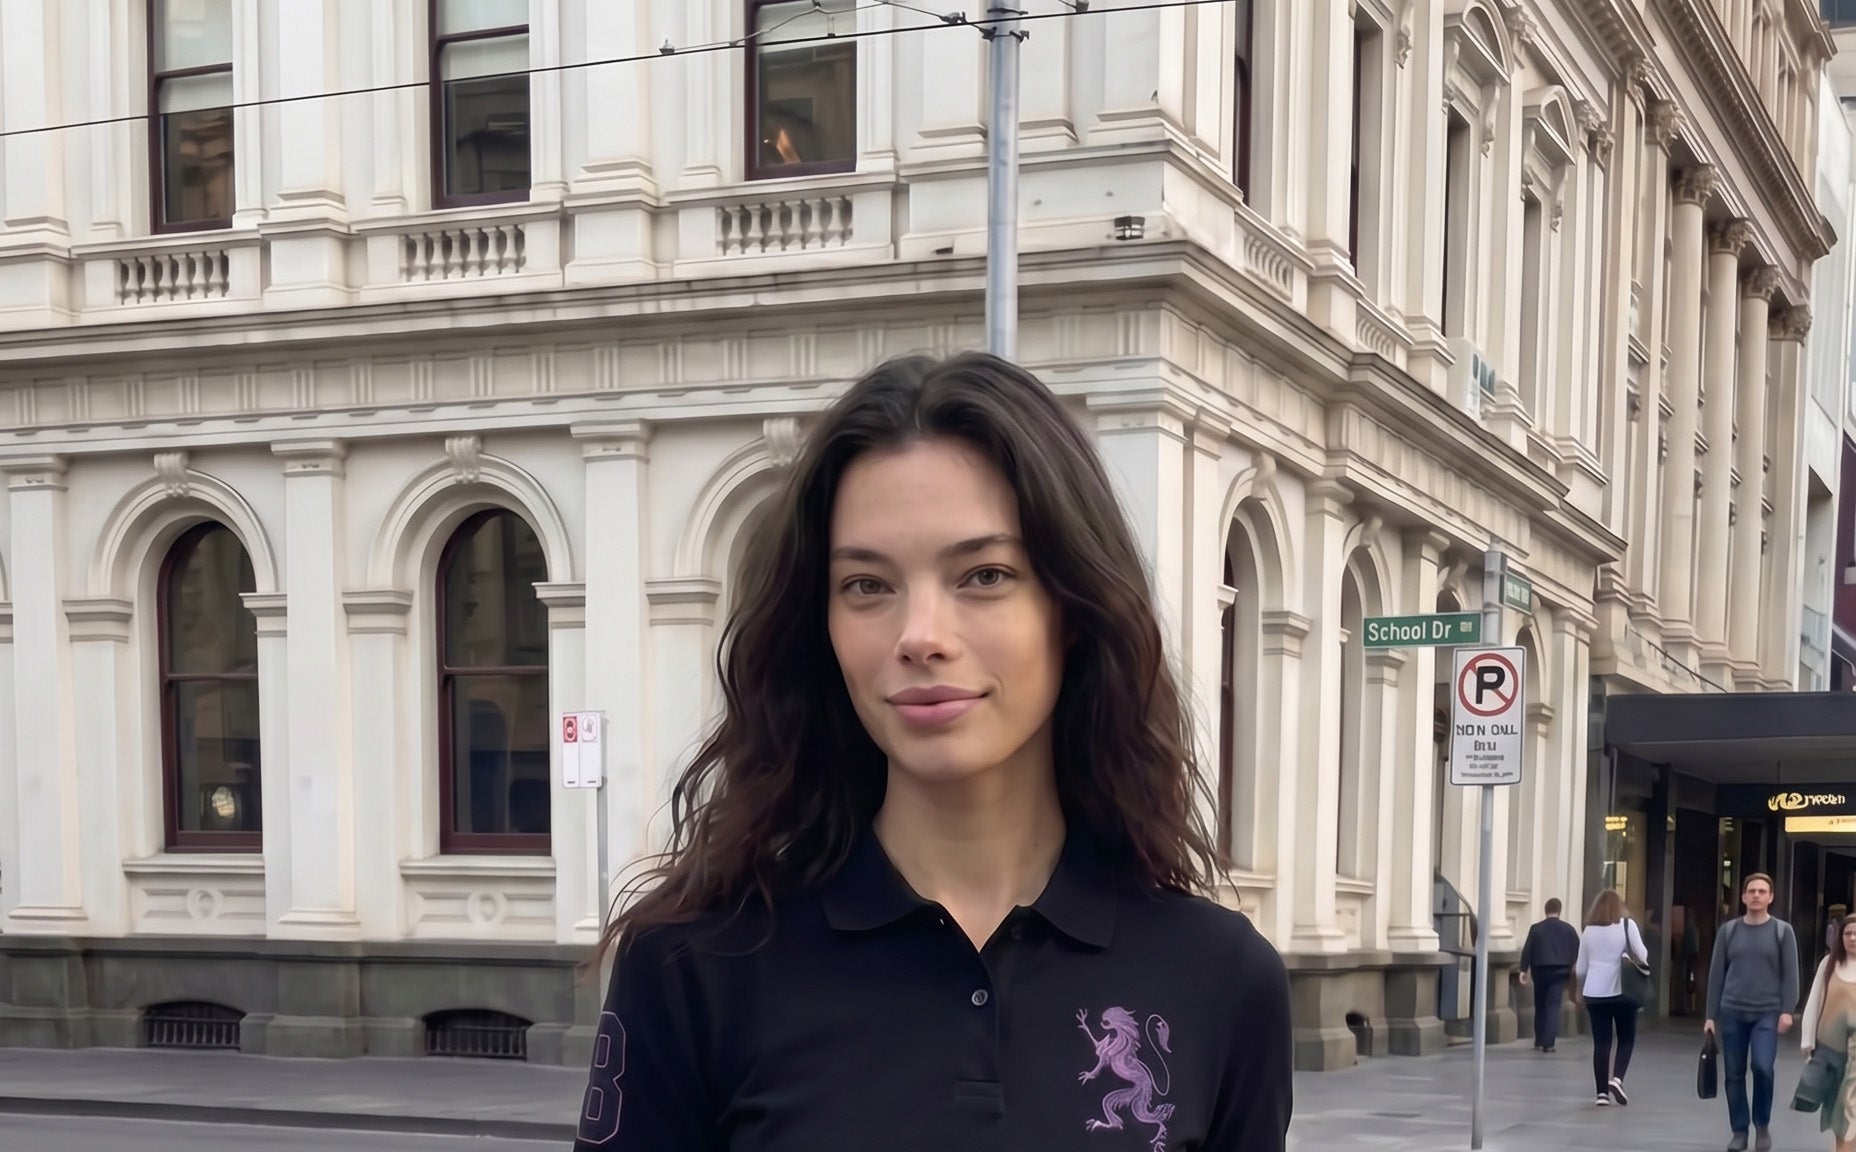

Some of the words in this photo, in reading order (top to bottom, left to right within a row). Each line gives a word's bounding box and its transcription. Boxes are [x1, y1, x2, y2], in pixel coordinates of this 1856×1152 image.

[1368, 621, 1426, 641] School
[1432, 620, 1452, 639] Dr
[1475, 666, 1506, 705] P
